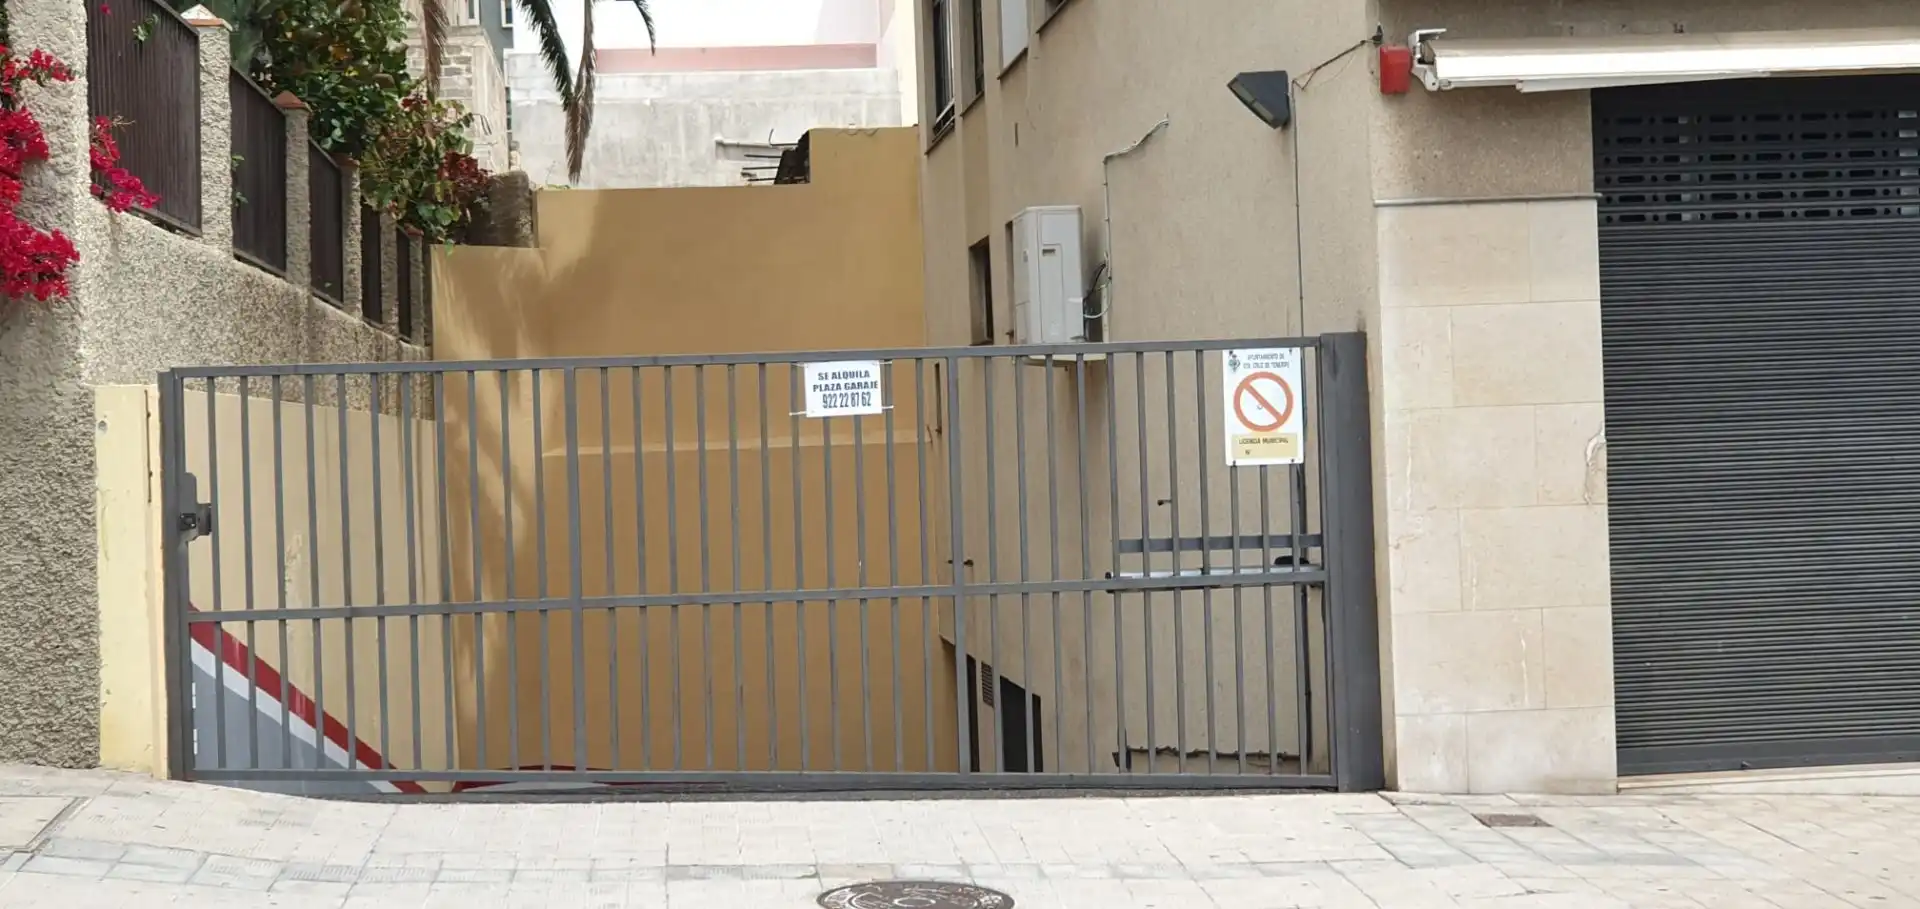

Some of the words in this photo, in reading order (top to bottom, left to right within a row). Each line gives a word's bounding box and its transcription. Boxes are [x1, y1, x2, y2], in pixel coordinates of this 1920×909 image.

[818, 372, 829, 380] SE
[831, 370, 871, 380] ALQUILA
[813, 383, 842, 392] PLAZA
[844, 381, 878, 391] GARAJE
[822, 393, 838, 409] 922
[839, 392, 849, 408] 22
[861, 391, 872, 407] 62
